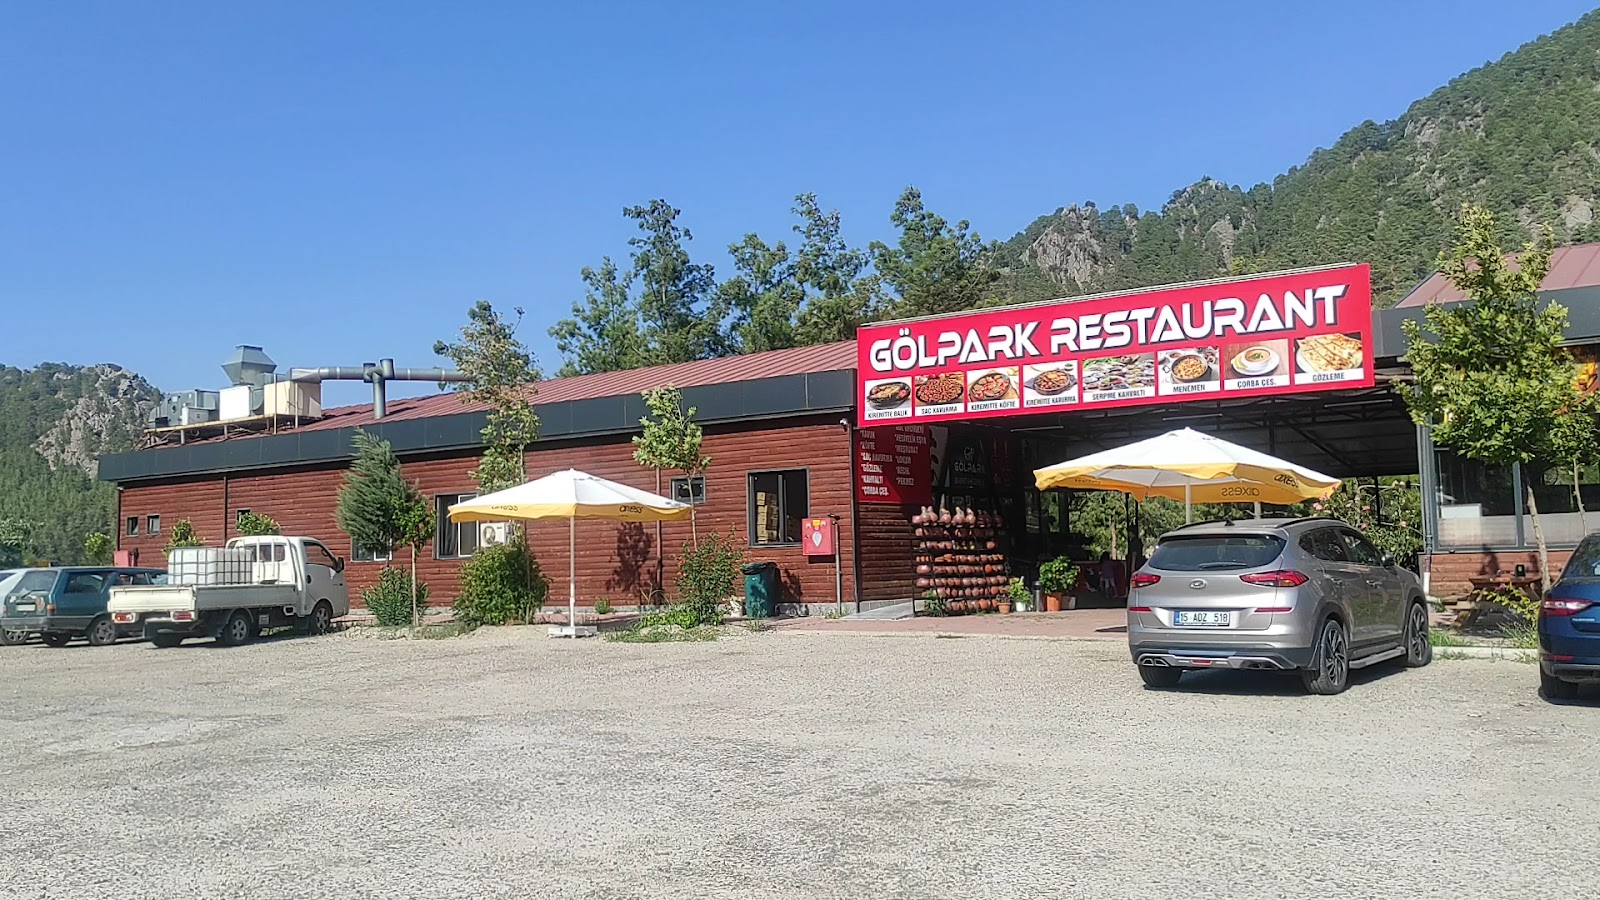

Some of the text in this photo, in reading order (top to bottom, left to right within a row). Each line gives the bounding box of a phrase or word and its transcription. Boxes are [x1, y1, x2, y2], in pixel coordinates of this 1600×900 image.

[870, 284, 1348, 372] GÖLPARK RESTAURANT
[1312, 372, 1345, 382] GÖZLEME
[1172, 384, 1206, 393] MENEMEN
[1237, 380, 1260, 389] ÇORBA
[1092, 389, 1146, 401] SERPME KAHVALTI
[1180, 612, 1228, 622] 15 ADZ 518
